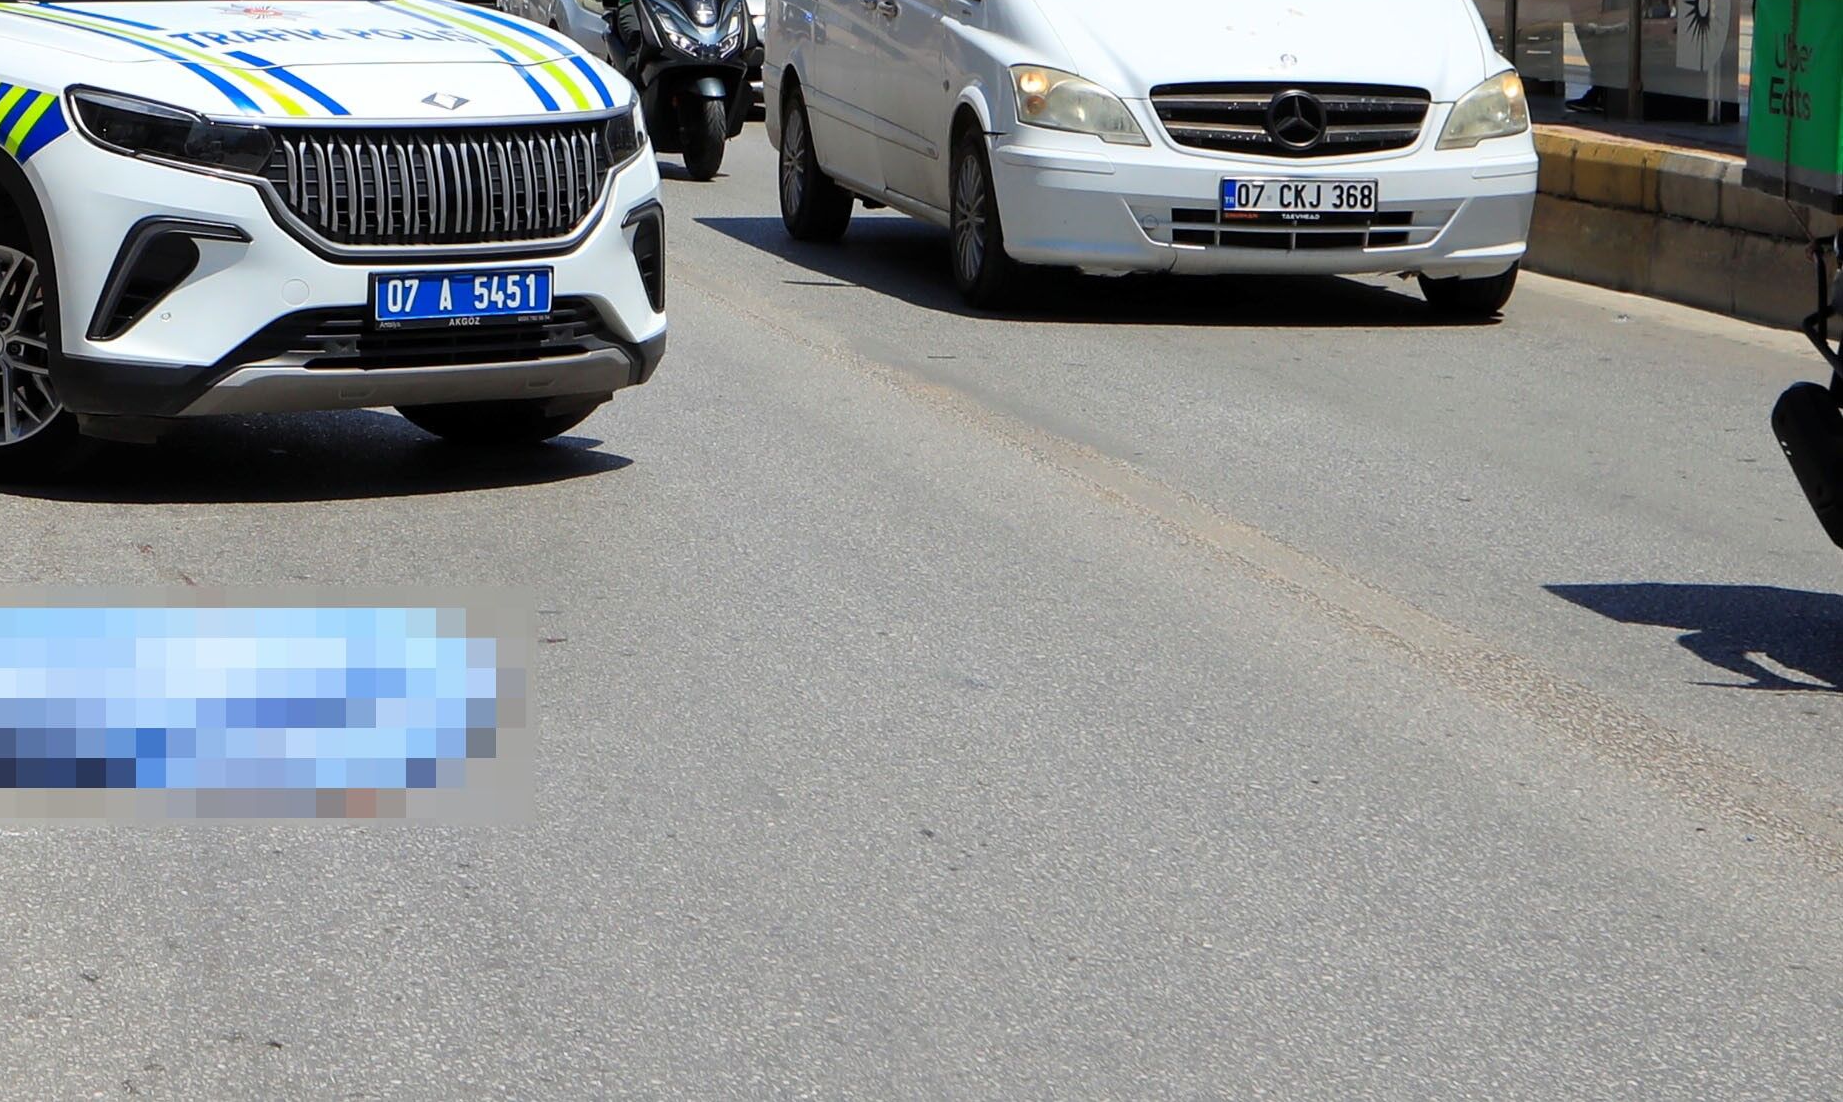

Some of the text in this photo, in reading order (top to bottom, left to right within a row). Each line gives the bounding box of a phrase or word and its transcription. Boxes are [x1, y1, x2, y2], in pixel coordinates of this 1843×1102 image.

[1237, 183, 1265, 208] 07
[1279, 184, 1321, 209] CKJ
[1332, 184, 1372, 209] 368
[387, 273, 536, 313] 07 A 5451
